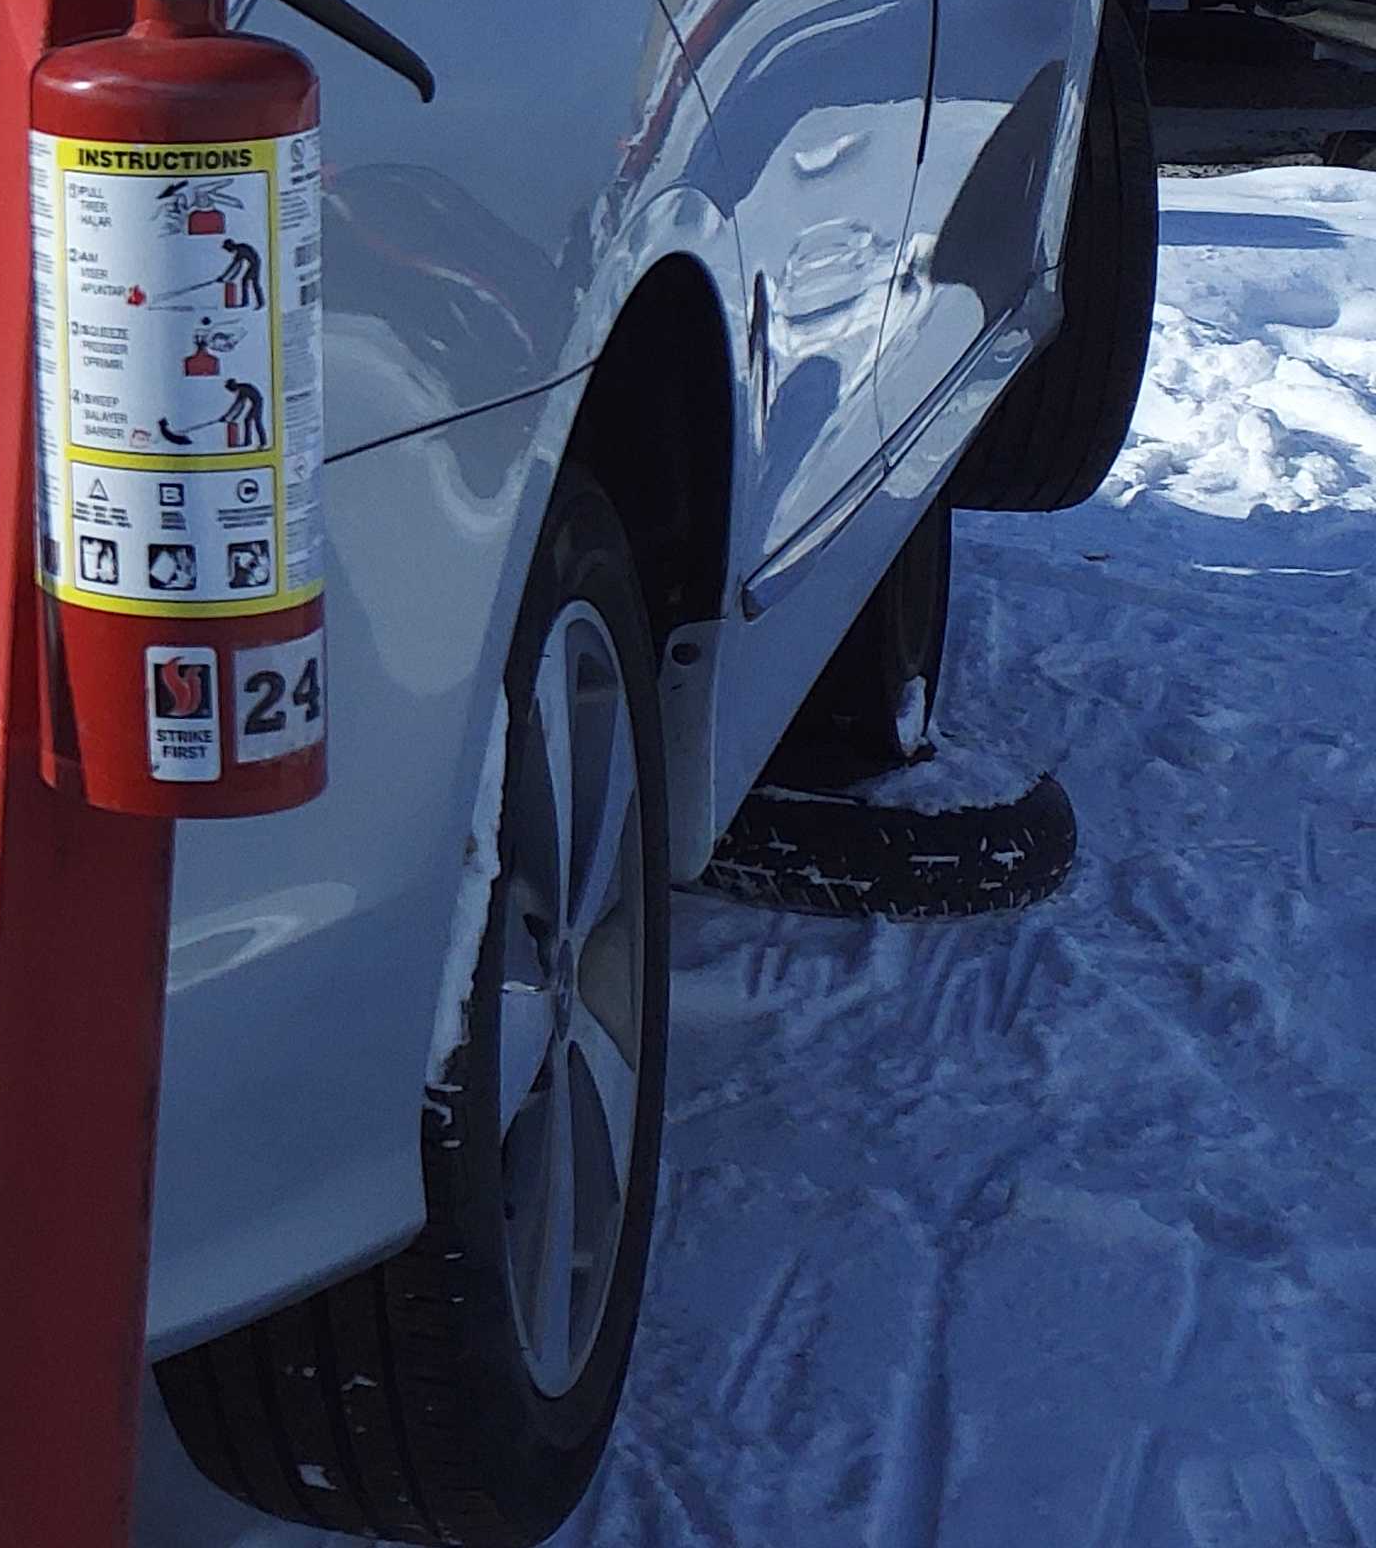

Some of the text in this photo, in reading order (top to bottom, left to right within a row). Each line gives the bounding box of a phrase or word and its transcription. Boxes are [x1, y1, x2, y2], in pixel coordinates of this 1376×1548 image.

[78, 147, 253, 171] INSTRUCTIONS
[238, 479, 259, 502] C
[243, 657, 321, 736] 24
[155, 729, 214, 744] STRIKE
[162, 745, 208, 759] FIRST
